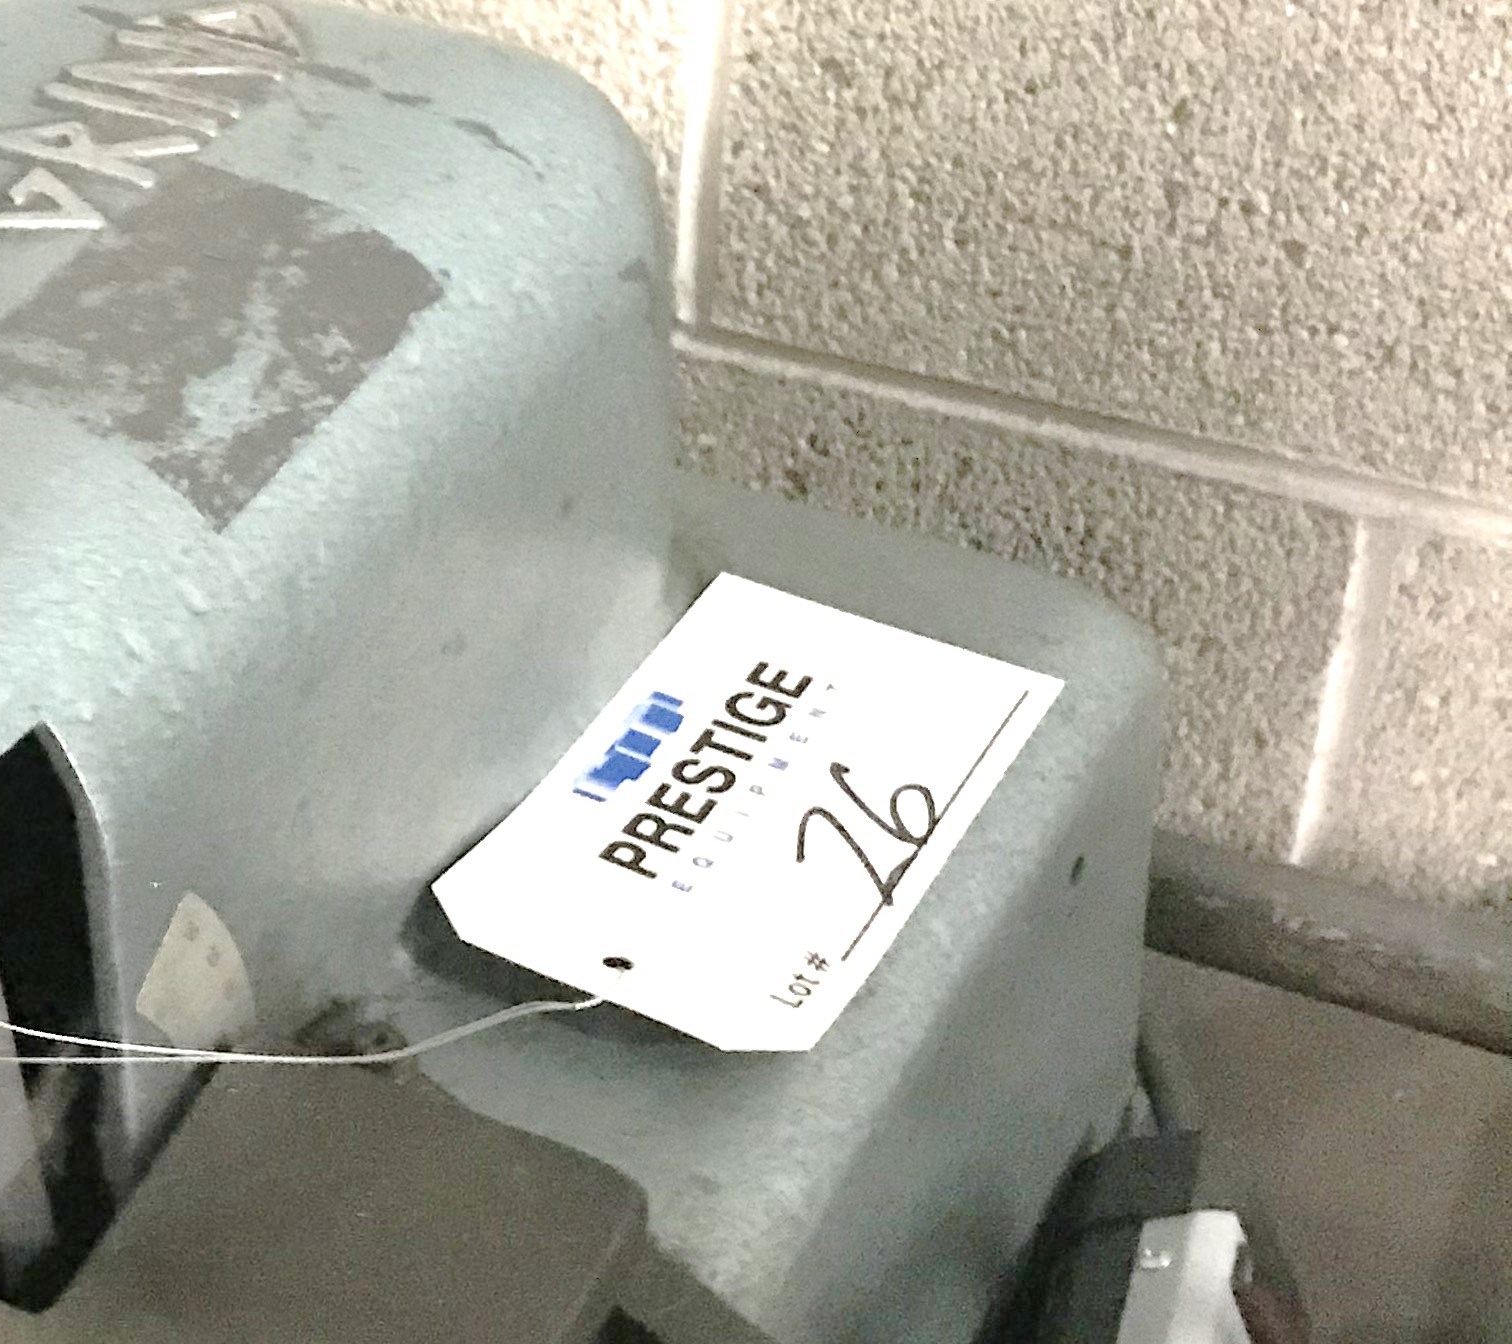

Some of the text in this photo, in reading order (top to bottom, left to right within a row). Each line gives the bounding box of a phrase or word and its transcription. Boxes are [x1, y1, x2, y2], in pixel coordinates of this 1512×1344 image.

[598, 661, 813, 879] PRESTIGE
[671, 682, 838, 893] EQUIPMENT
[769, 761, 939, 1008] Lot # 26
